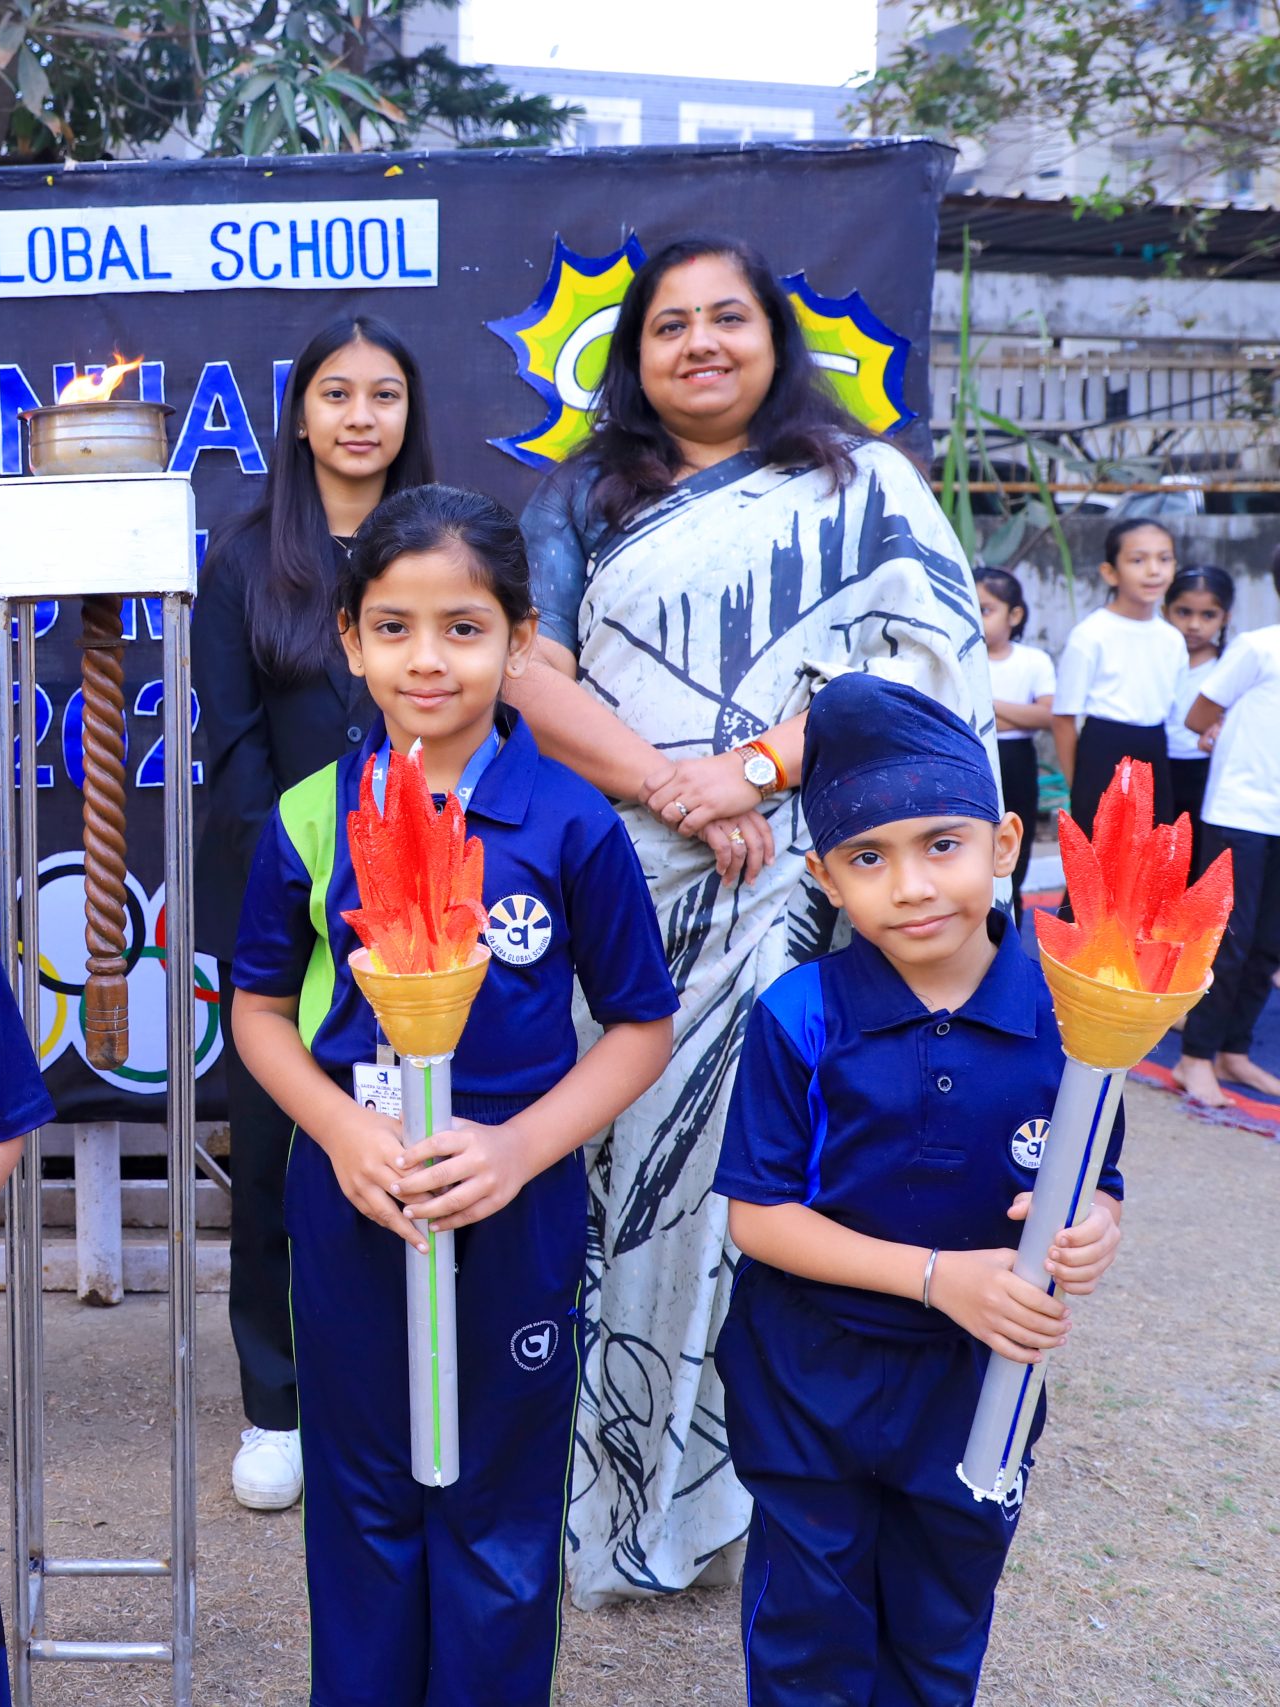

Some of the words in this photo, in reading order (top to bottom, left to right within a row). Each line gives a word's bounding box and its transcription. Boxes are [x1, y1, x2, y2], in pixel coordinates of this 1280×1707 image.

[210, 217, 432, 281] SCHOOL
[487, 935, 508, 959] GAJERA
[507, 953, 533, 963] GLOBAL
[532, 935, 550, 958] SCHOOL
